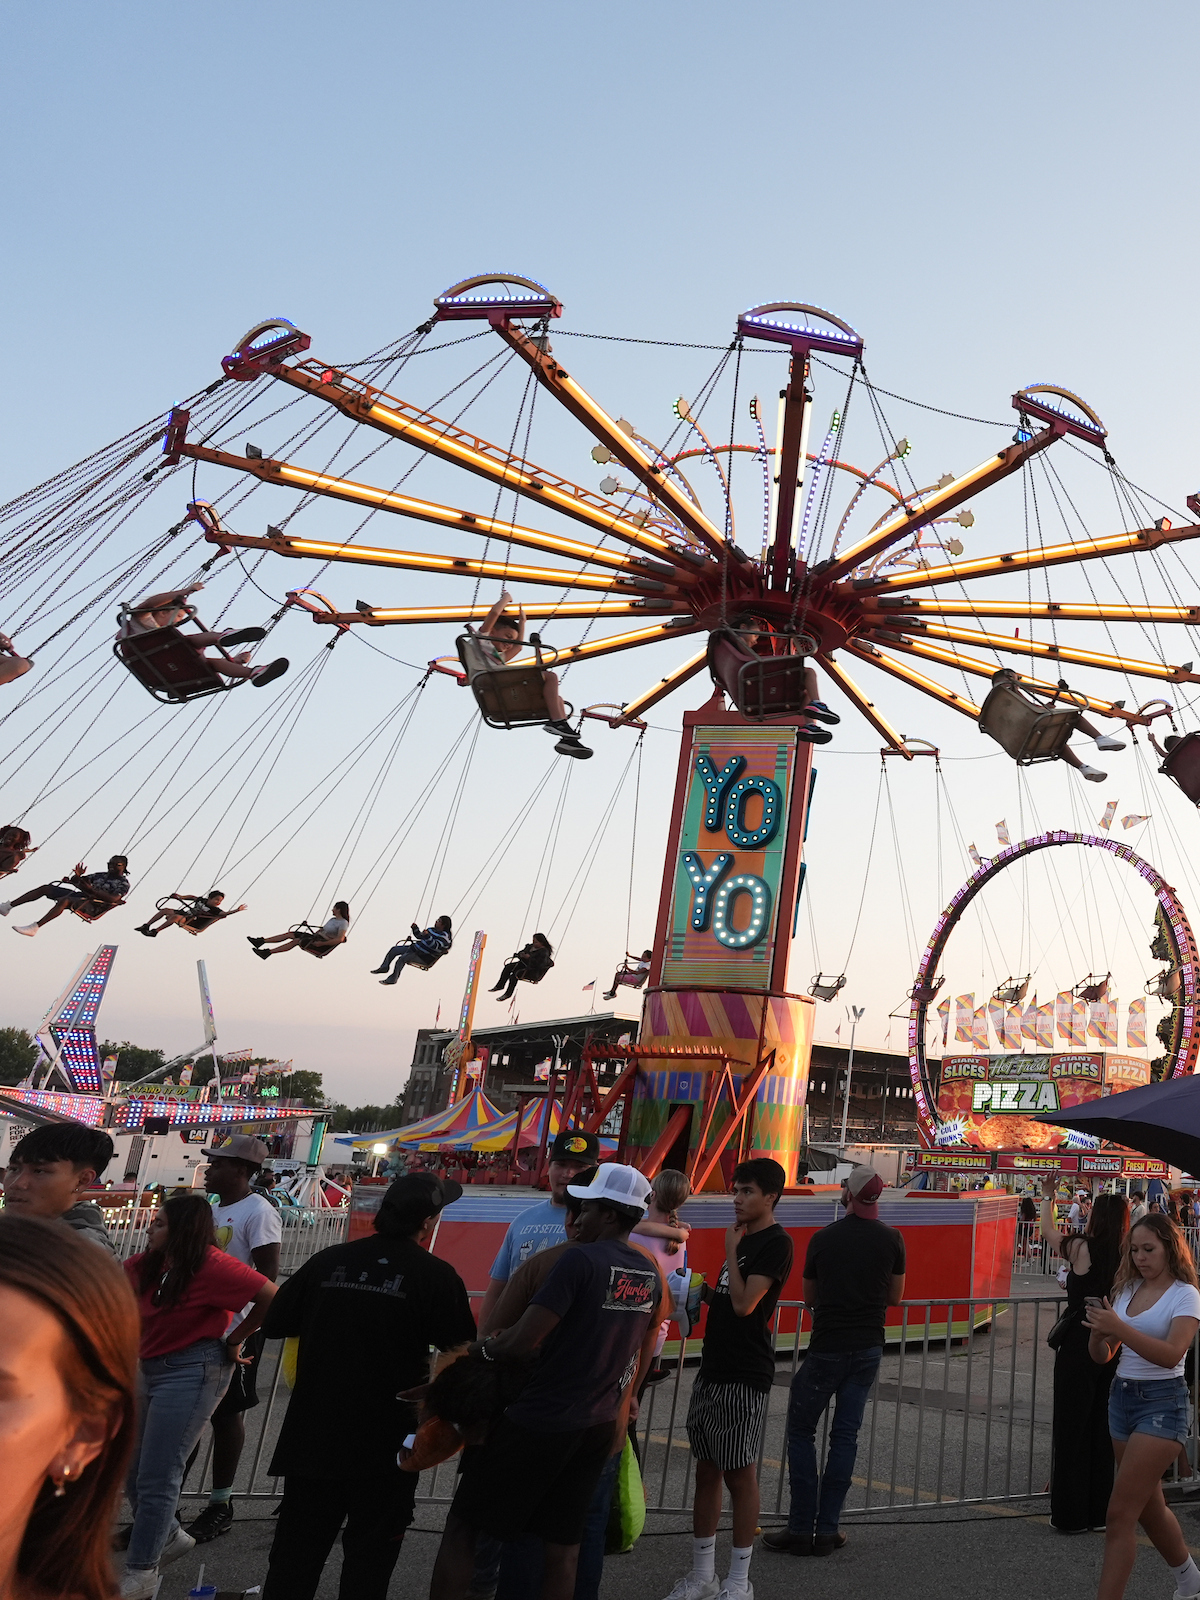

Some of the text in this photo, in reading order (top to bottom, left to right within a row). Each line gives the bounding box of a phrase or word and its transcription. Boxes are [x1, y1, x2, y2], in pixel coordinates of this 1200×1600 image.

[695, 754, 783, 850] YO
[682, 850, 772, 951] YO
[950, 1057, 981, 1065] GIANT
[1015, 1056, 1050, 1076] Fresh
[1059, 1055, 1093, 1063] GIANT
[1128, 1060, 1146, 1069] BAKED
[943, 1063, 986, 1079] SLICES
[1052, 1061, 1099, 1078] SLICES
[1108, 1065, 1148, 1084] PIZZA
[973, 1082, 1058, 1110] PIZZA
[189, 1129, 207, 1140] CAT
[940, 1123, 958, 1135] COLD
[938, 1133, 963, 1146] DRINKS
[1068, 1132, 1095, 1149] DRINKS
[922, 1153, 987, 1167] PEPPERONI
[1013, 1155, 1062, 1170] CHEESE
[1083, 1160, 1120, 1171] DRINKS
[1125, 1160, 1164, 1172] FRESH PIZZA
[520, 1224, 540, 1235] LET'S
[614, 1278, 651, 1301] Hurley
